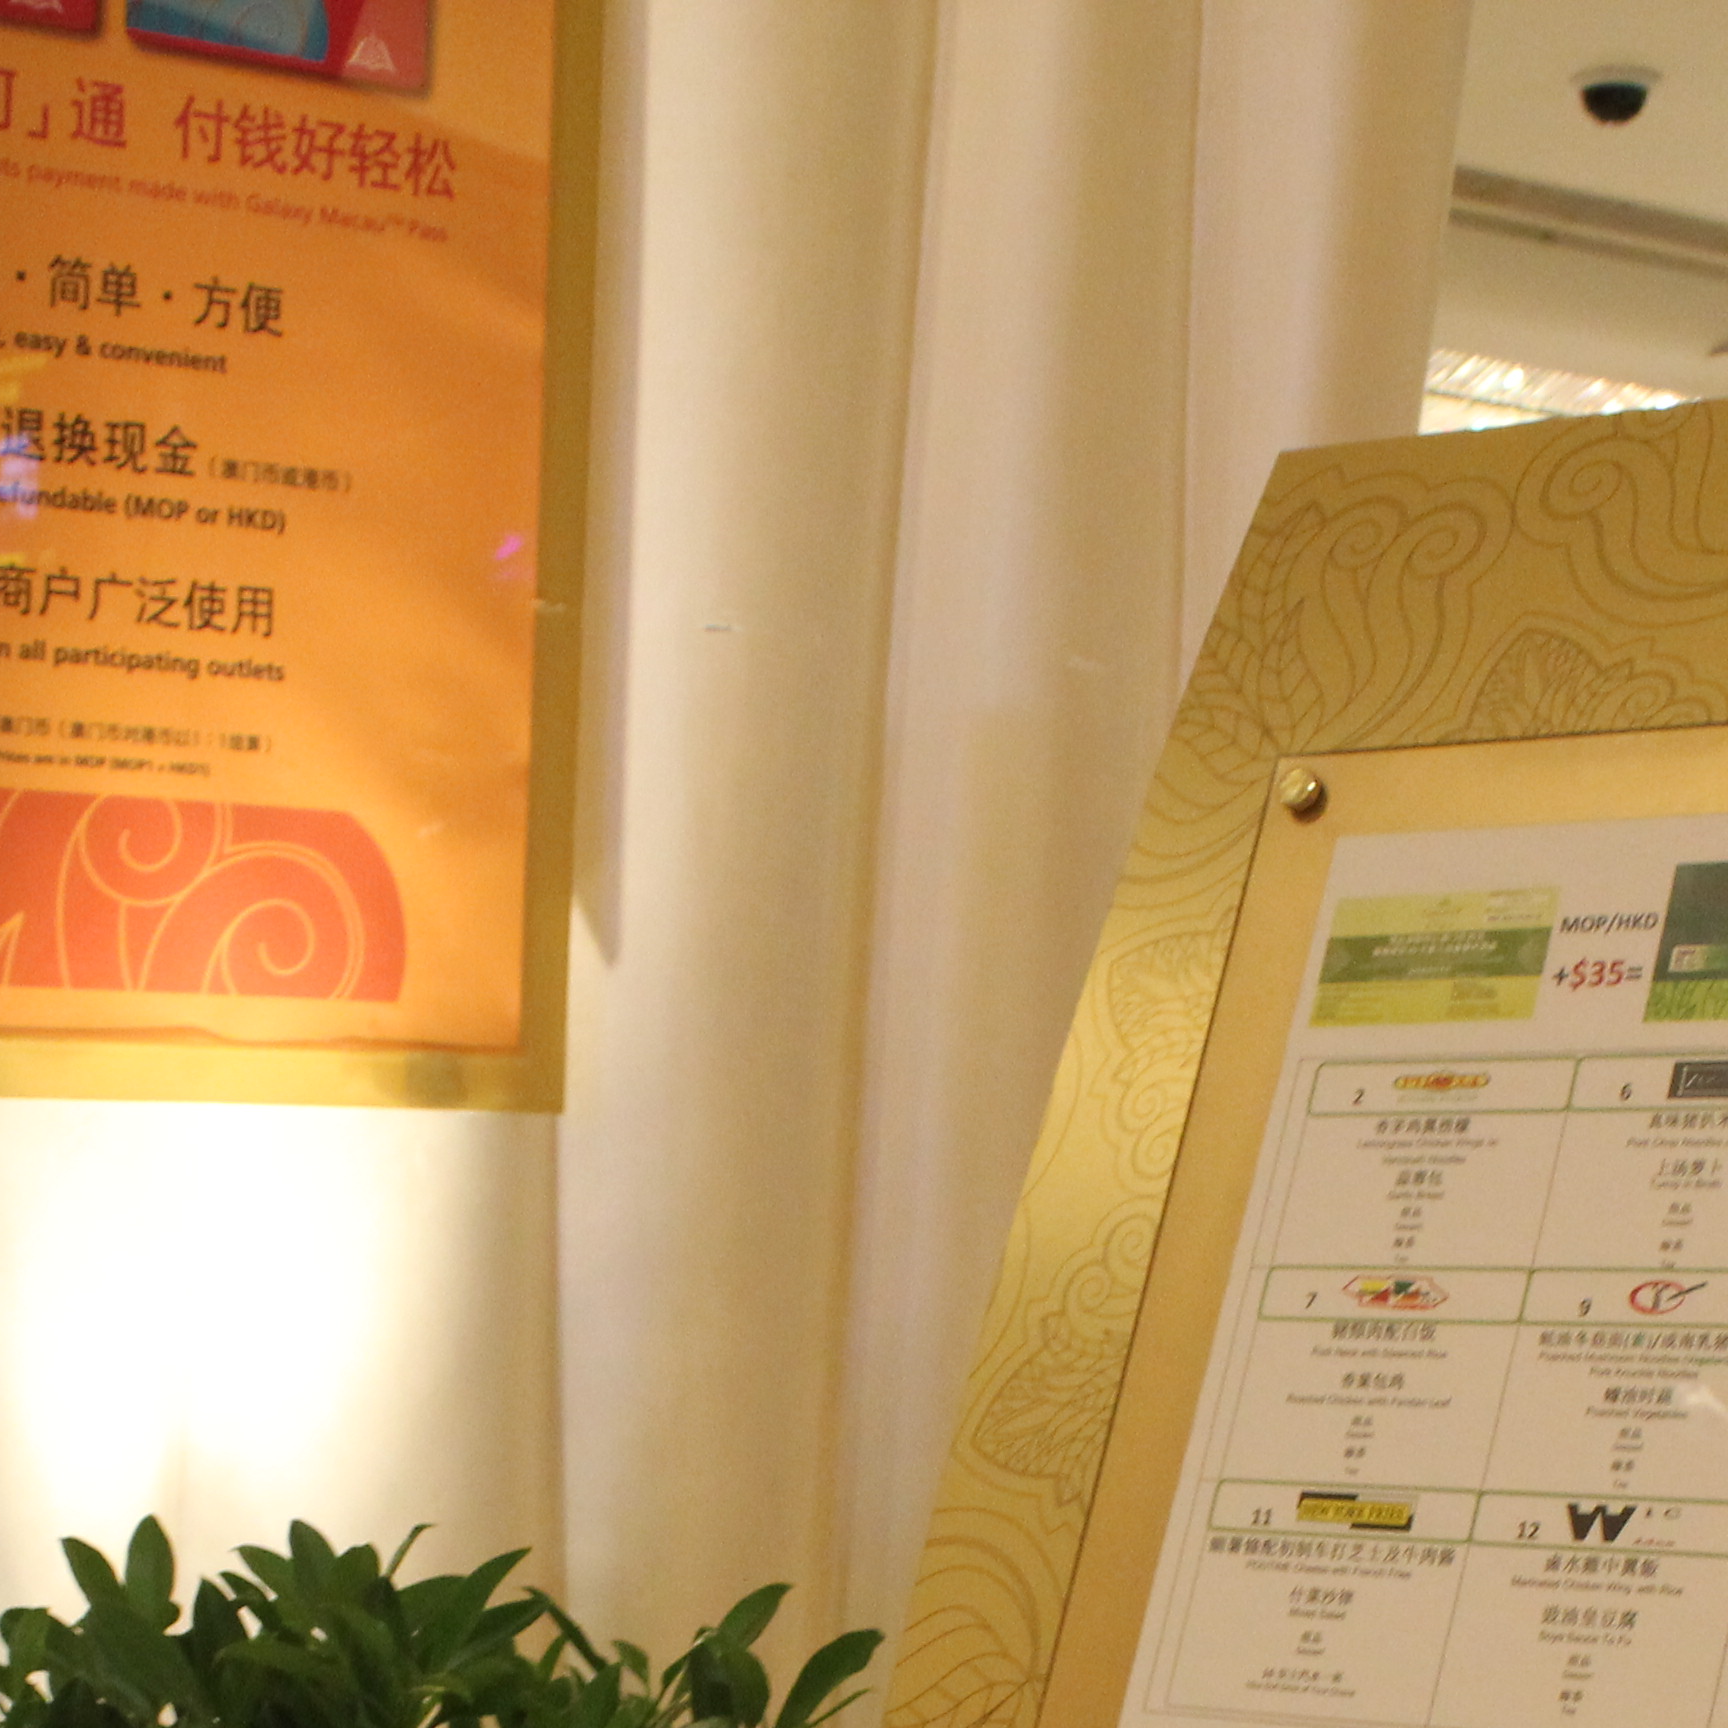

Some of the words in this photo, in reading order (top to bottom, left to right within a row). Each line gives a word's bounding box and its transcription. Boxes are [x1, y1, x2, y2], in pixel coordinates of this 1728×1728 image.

[174, 95, 455, 200] 付钱好轻松
[14, 328, 68, 358] easy
[74, 335, 92, 356] &
[99, 341, 227, 374] convenient
[124, 491, 190, 523] (MOP
[196, 505, 218, 525] or
[227, 504, 286, 534] HKD)
[19, 638, 47, 662] all
[52, 642, 201, 680] participating
[207, 655, 285, 682] outlets
[1559, 912, 1659, 935] MOP/HKD
[1352, 1087, 1366, 1106] 2
[1250, 1507, 1272, 1526] 11
[1516, 1520, 1541, 1540] 12
